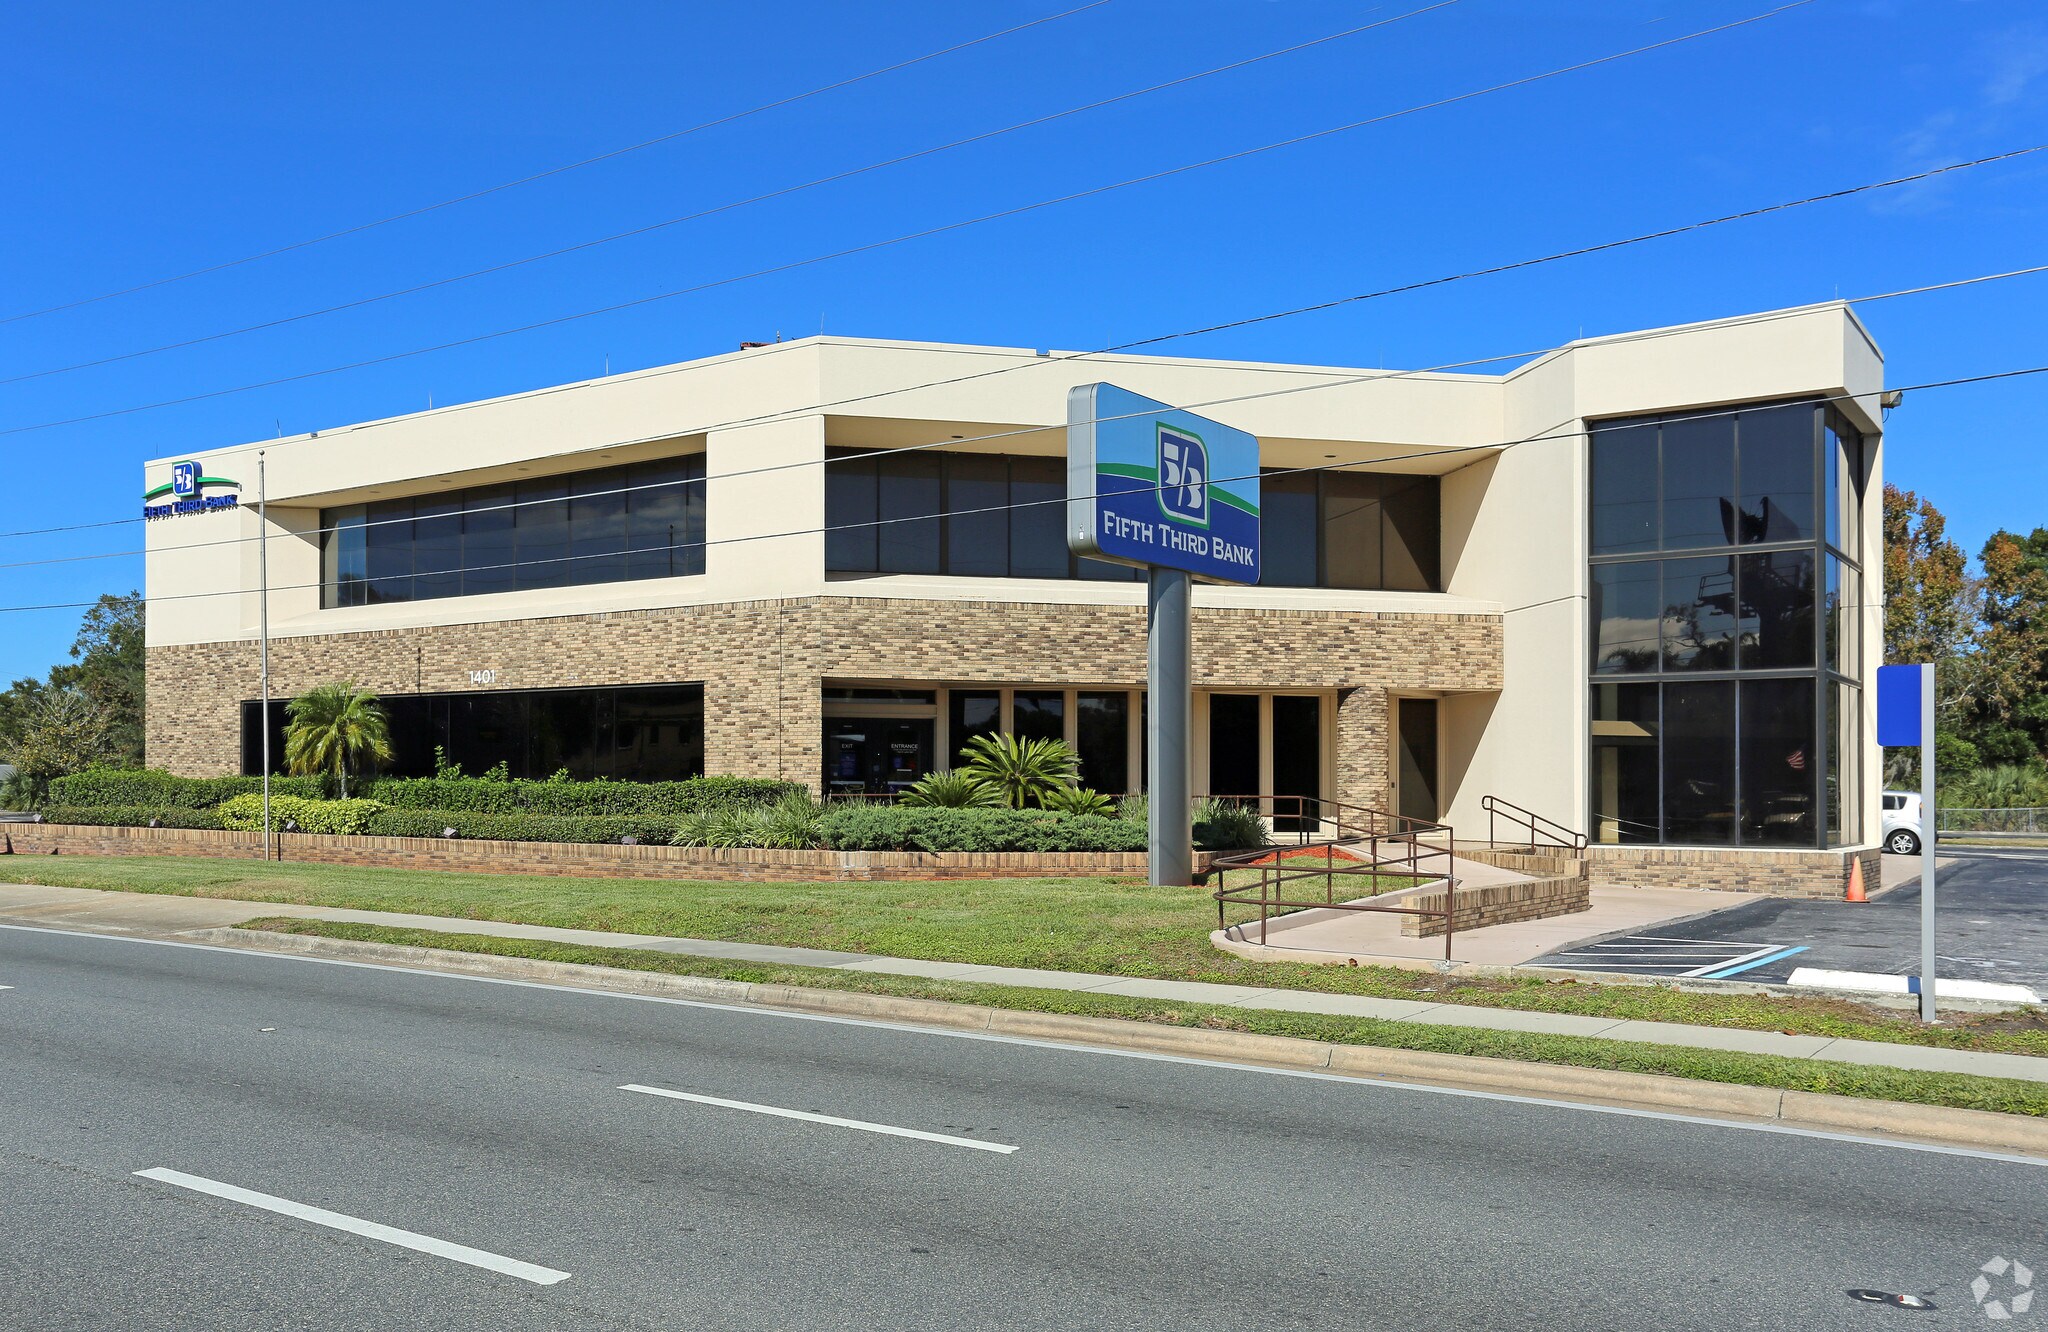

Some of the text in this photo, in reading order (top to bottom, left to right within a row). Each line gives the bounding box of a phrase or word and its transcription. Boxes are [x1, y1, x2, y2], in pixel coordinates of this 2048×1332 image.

[143, 494, 238, 518] FIFTH THIRD BANK
[1103, 510, 1254, 567] FIFTH THIRD BANK
[469, 669, 496, 685] 1401
